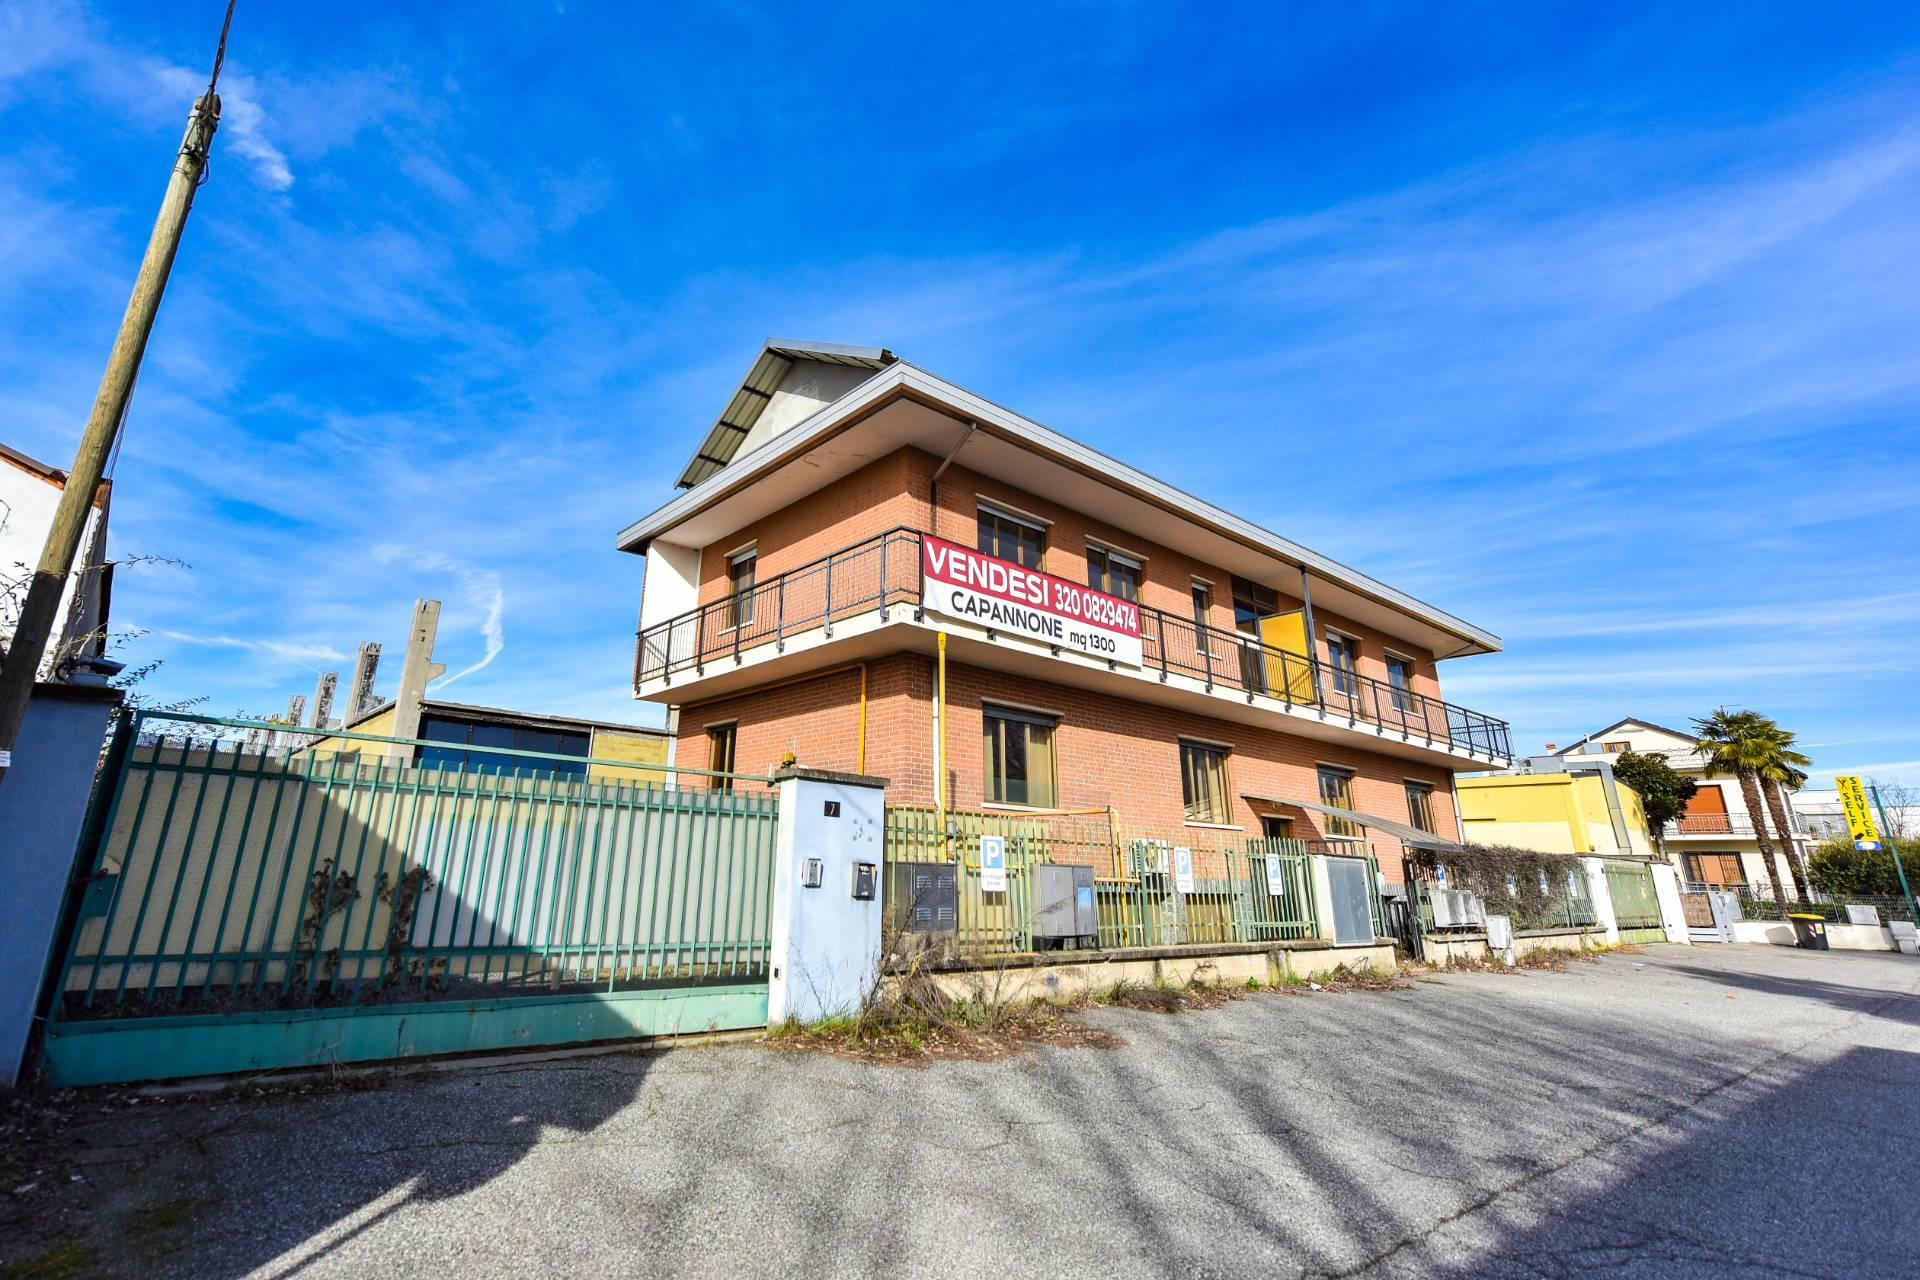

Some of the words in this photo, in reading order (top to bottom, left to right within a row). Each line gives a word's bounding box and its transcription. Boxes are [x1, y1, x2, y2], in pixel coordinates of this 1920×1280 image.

[926, 541, 1049, 607] VENDESI
[1054, 583, 1081, 616] 320
[1083, 593, 1138, 632] 0829474
[951, 591, 1063, 639] CAPANNONE
[1069, 631, 1087, 651] mq
[1089, 634, 1116, 653] 1300
[830, 803, 835, 816] 7
[1843, 793, 1857, 827] SELF
[1849, 777, 1873, 837] SERVICE
[987, 841, 1000, 866] P
